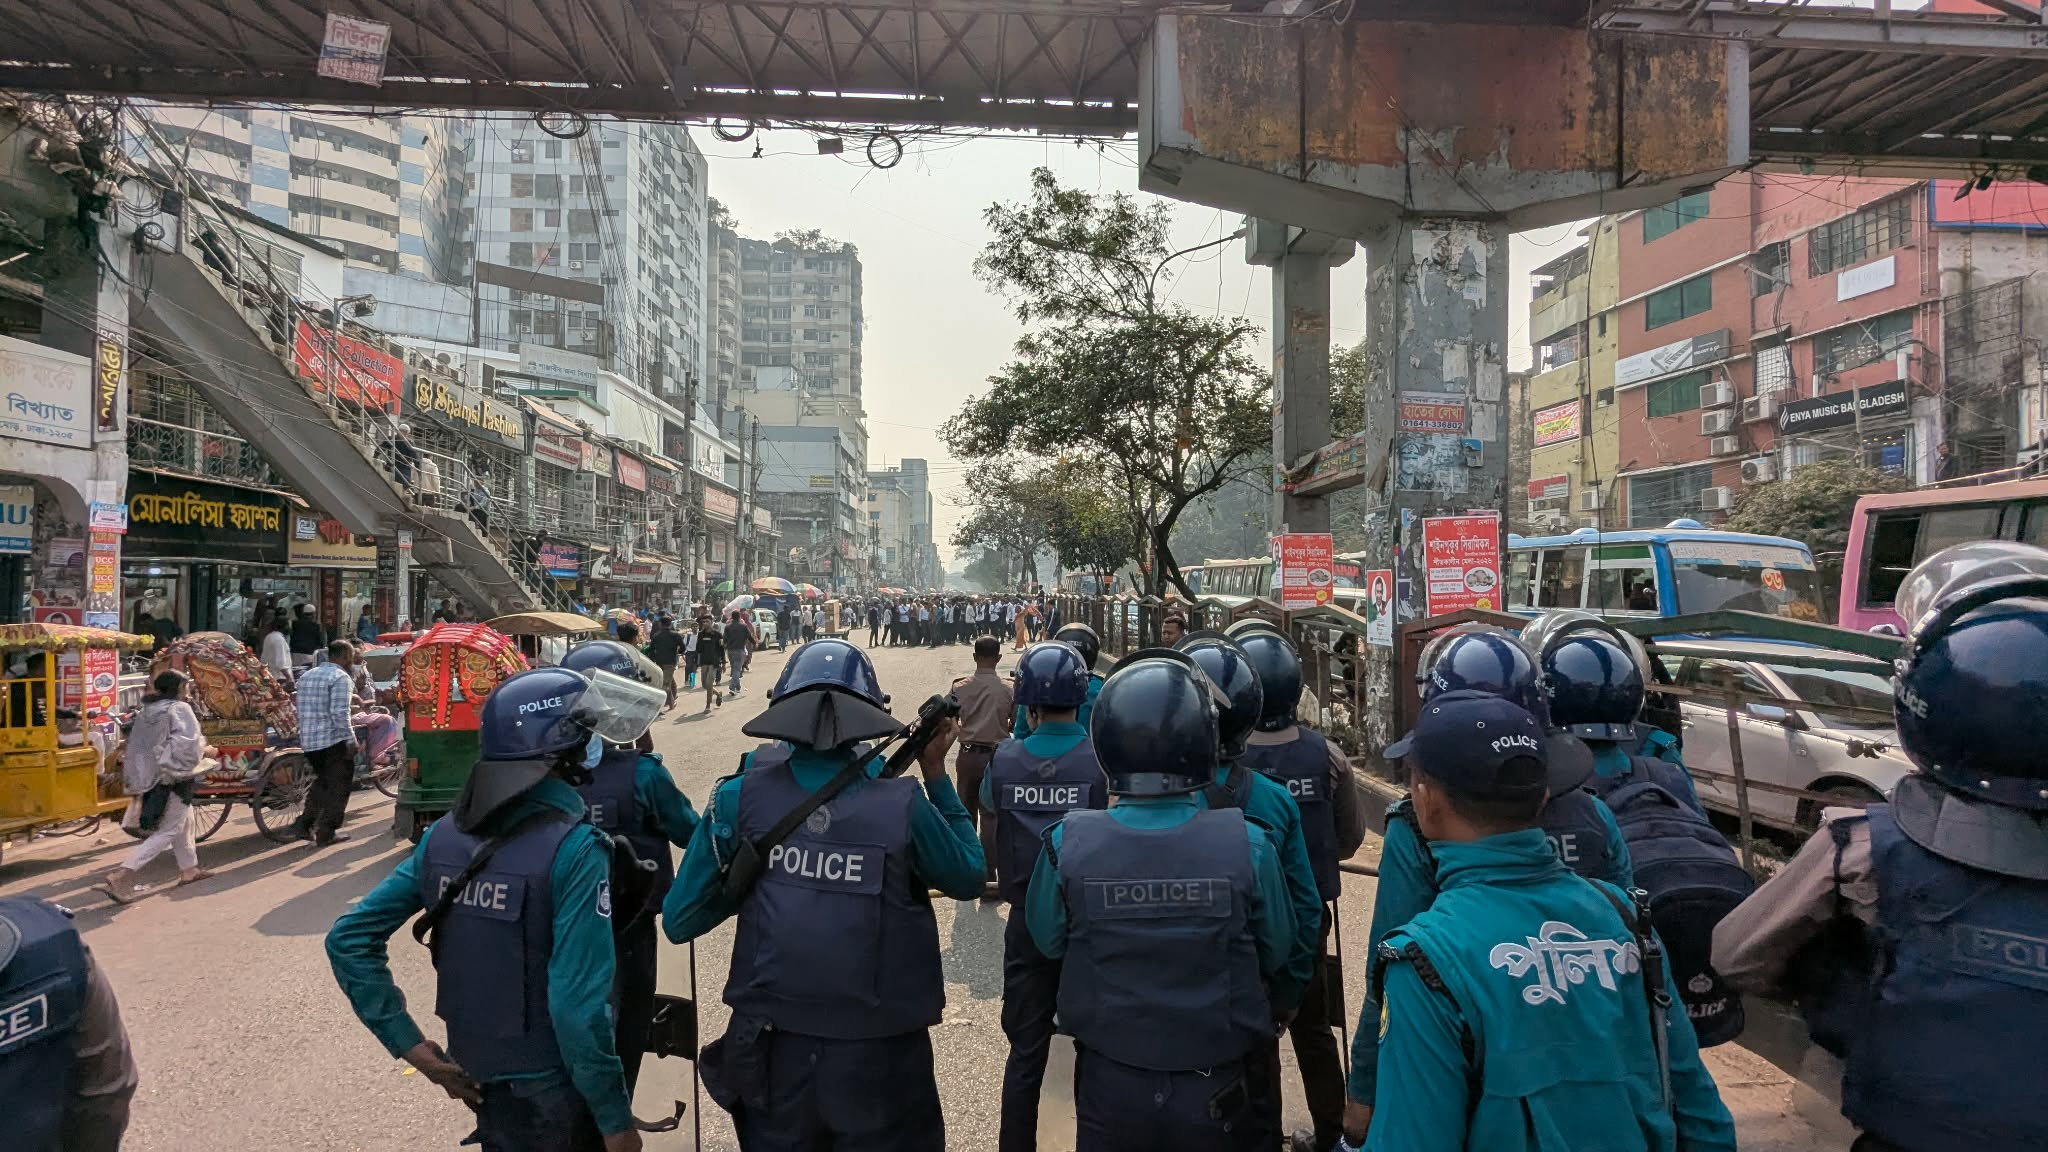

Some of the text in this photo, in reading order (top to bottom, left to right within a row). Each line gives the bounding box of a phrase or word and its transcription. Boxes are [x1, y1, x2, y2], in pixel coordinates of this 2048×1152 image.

[341, 345, 394, 376] Collection
[6, 392, 75, 420] বিখ্যাত
[436, 383, 481, 426] Shamsi
[482, 399, 519, 440] Fashion
[1403, 404, 1463, 420] হাতের লেখা
[1790, 391, 1905, 422] ENYA MUSIC BAGLADESH
[130, 490, 225, 528] মোনালিসা
[228, 503, 281, 532] ফ্যাশন
[95, 556, 114, 564] UCC
[95, 574, 114, 582] UCC
[611, 659, 634, 671] POLICE
[519, 696, 563, 715] POLICE
[1491, 734, 1539, 763] POLICE
[1013, 785, 1079, 805] POLICE
[768, 843, 865, 882] POLICE
[1113, 882, 1201, 903] POLICE
